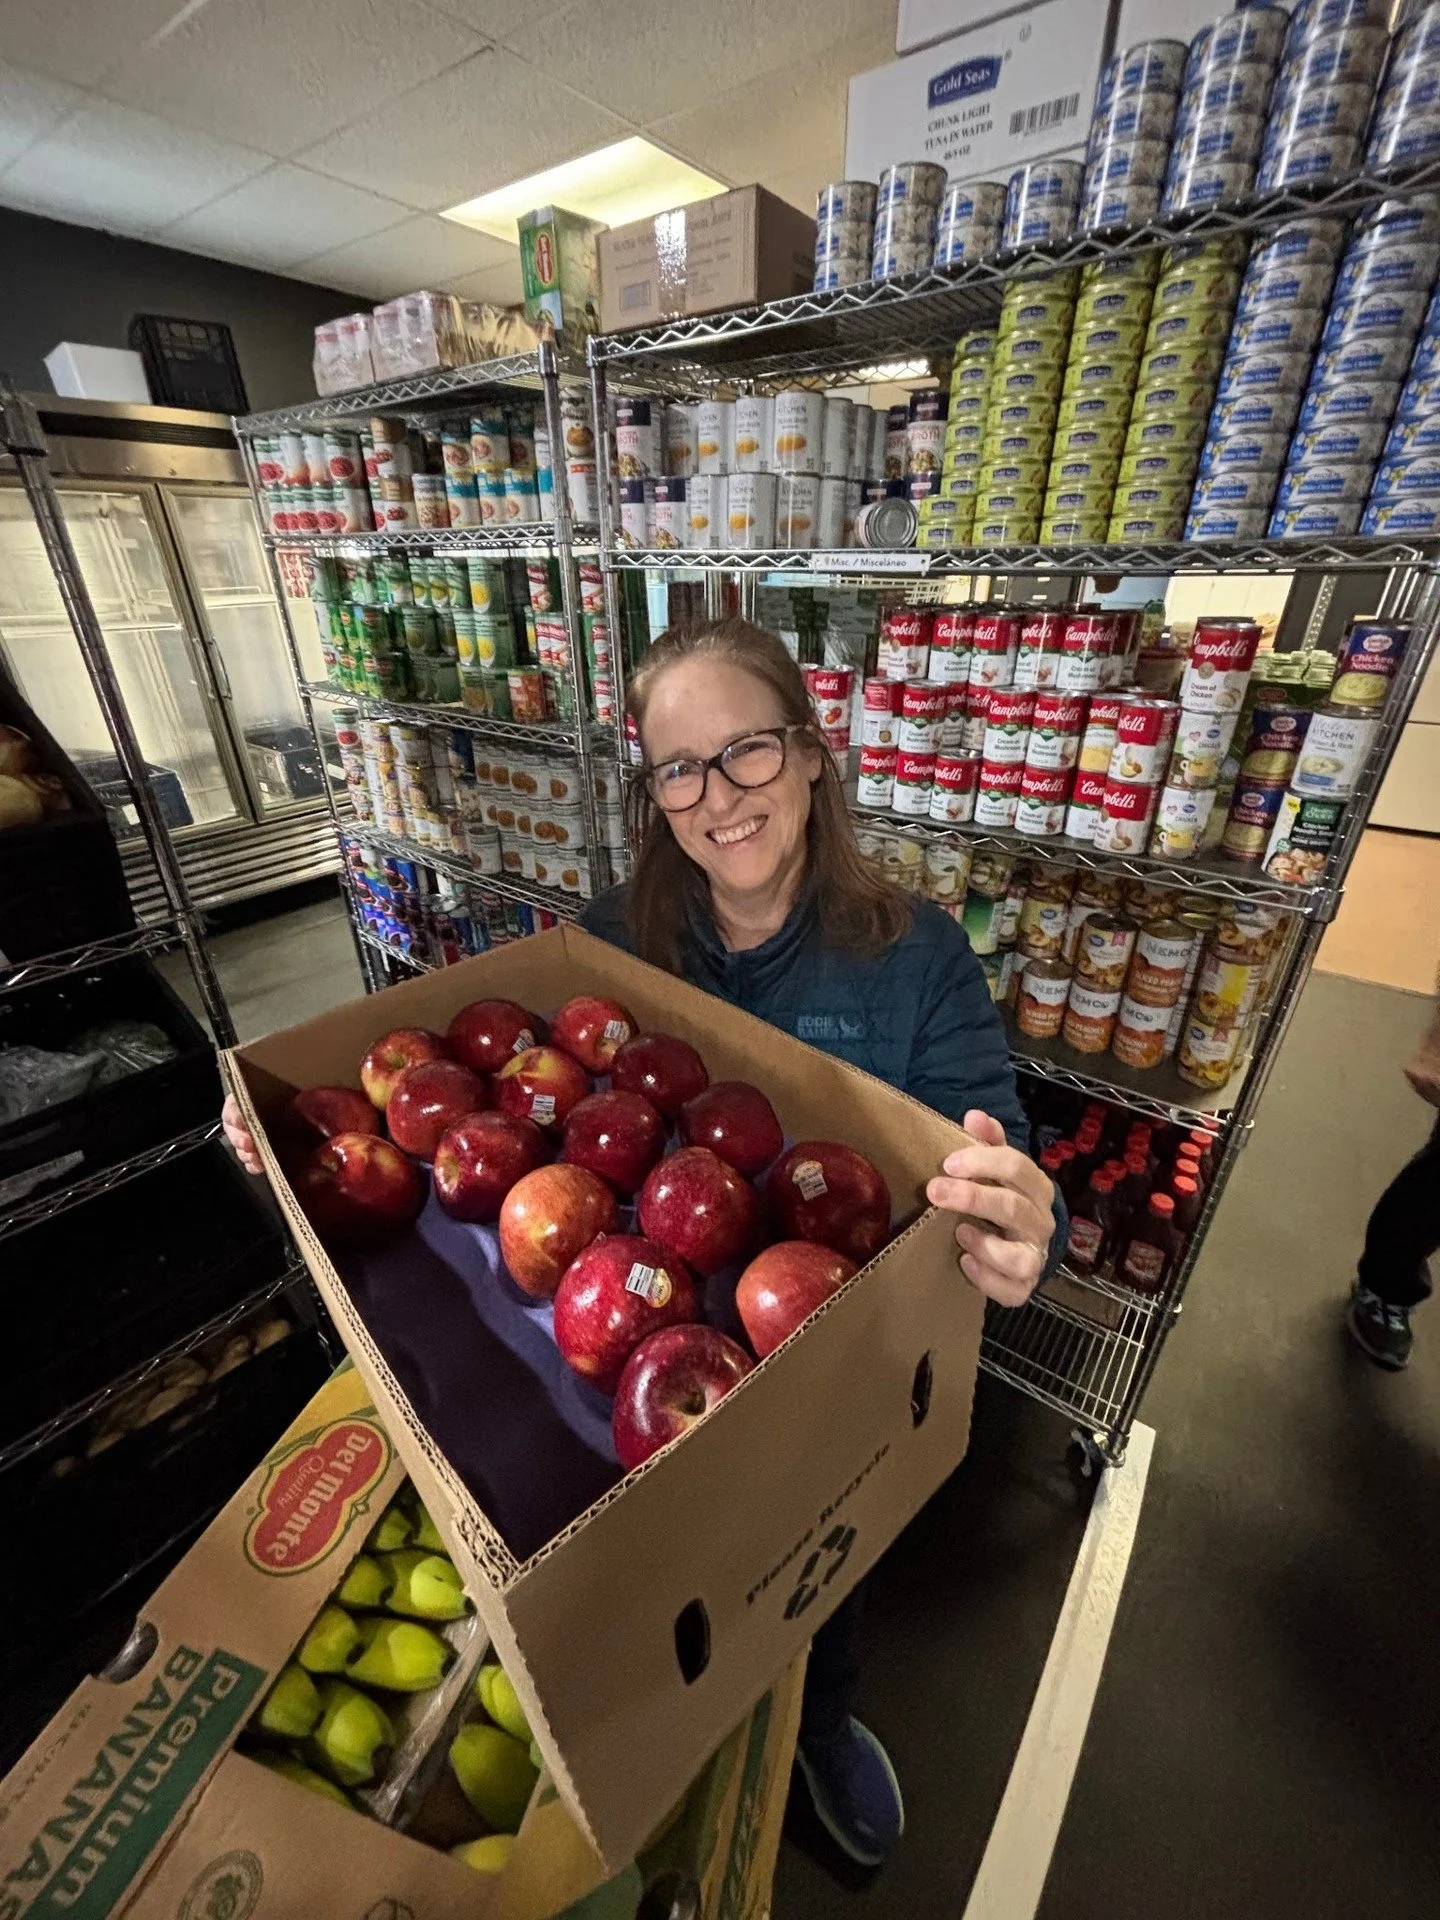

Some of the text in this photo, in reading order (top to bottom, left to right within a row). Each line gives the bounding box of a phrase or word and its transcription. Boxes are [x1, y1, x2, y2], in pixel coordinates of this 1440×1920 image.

[933, 68, 991, 97] Gold Seas
[928, 103, 991, 133] CHUNK LIGHT
[925, 120, 994, 151] TUNA IN WATER
[831, 558, 851, 567] Misc.
[860, 558, 908, 568] Misceláneo
[1351, 654, 1395, 665] Chicken
[1351, 662, 1389, 672] Noodle
[267, 1432, 373, 1562] Del Monte
[746, 1527, 813, 1605] Please
[52, 1662, 242, 1908] Premium
